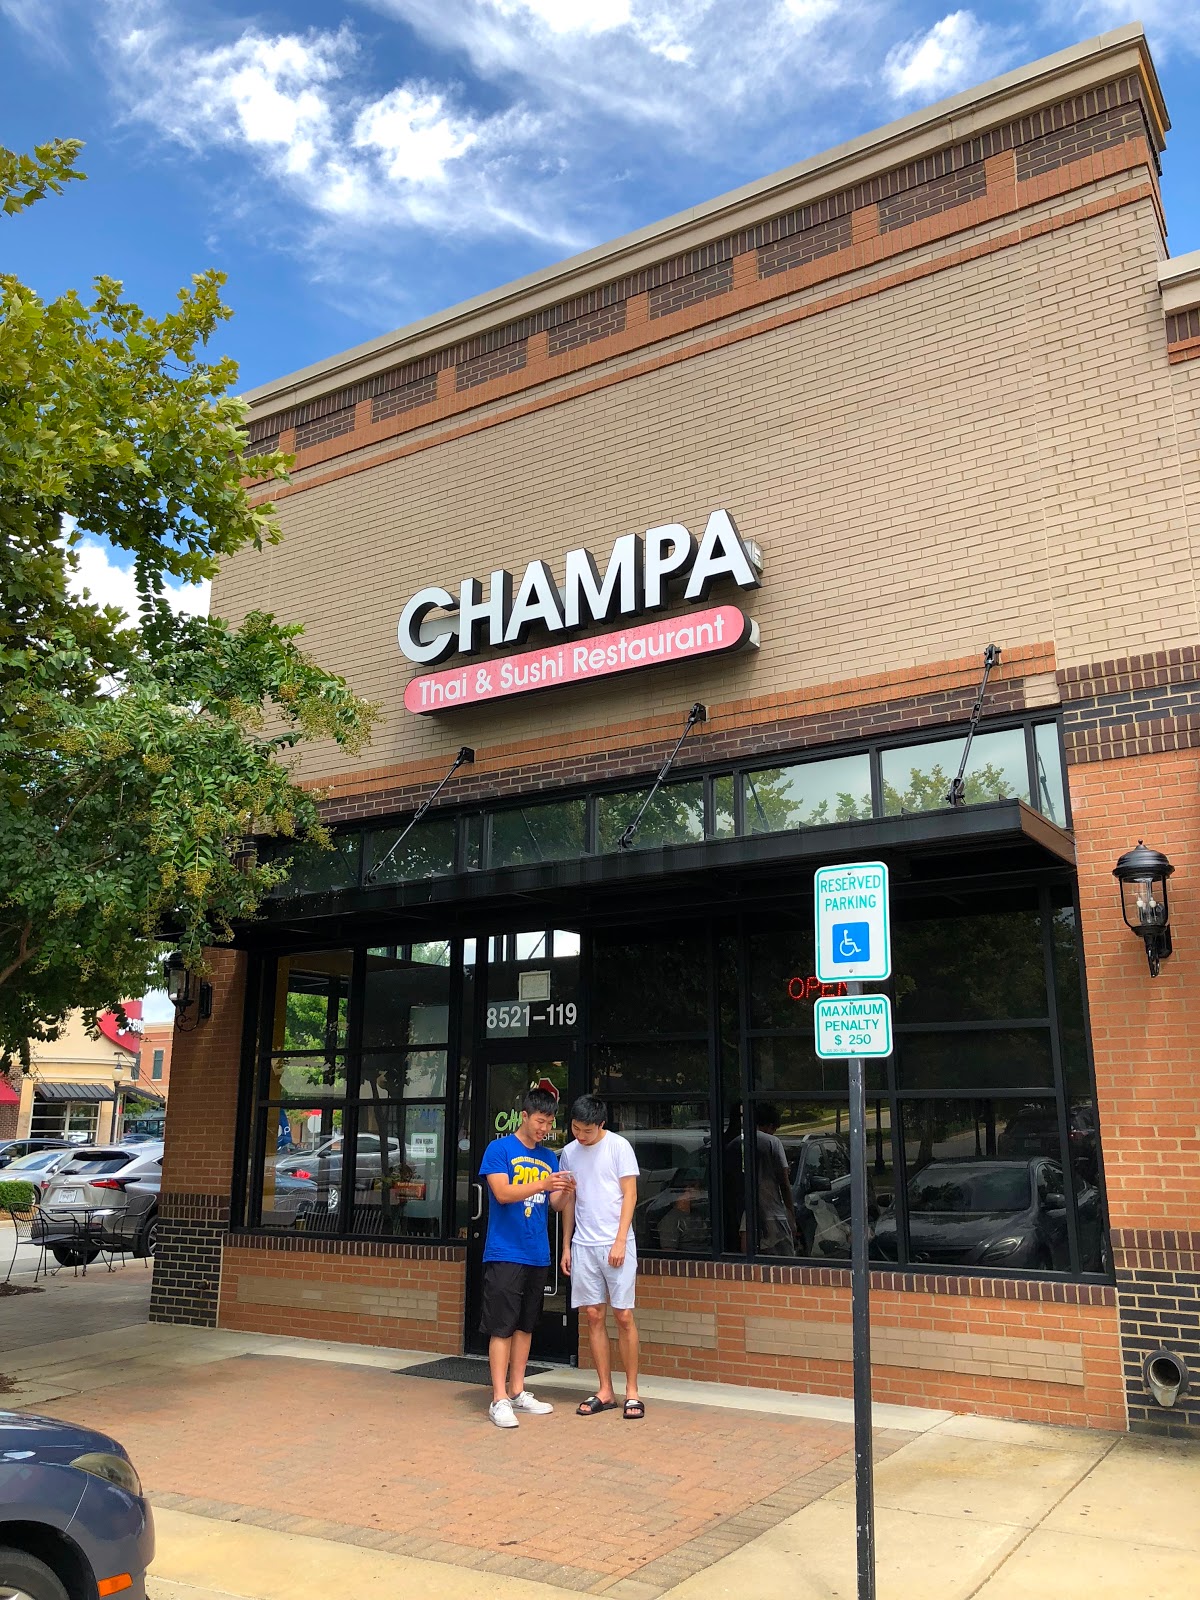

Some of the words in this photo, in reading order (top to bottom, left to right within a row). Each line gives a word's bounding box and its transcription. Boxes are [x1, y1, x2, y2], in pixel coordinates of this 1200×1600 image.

[397, 508, 757, 664] CHAMPA
[419, 673, 467, 706] Thai
[475, 668, 493, 694] &
[501, 651, 563, 690] Sushi
[573, 614, 725, 674] Restaurant
[820, 875, 881, 893] RESERVED
[825, 894, 877, 912] PARKING
[486, 1002, 578, 1029] 8521-119
[821, 1003, 884, 1017] MAXIMUM
[825, 1018, 880, 1031] PENALTY
[834, 1034, 842, 1046] $
[848, 1033, 872, 1045] 250
